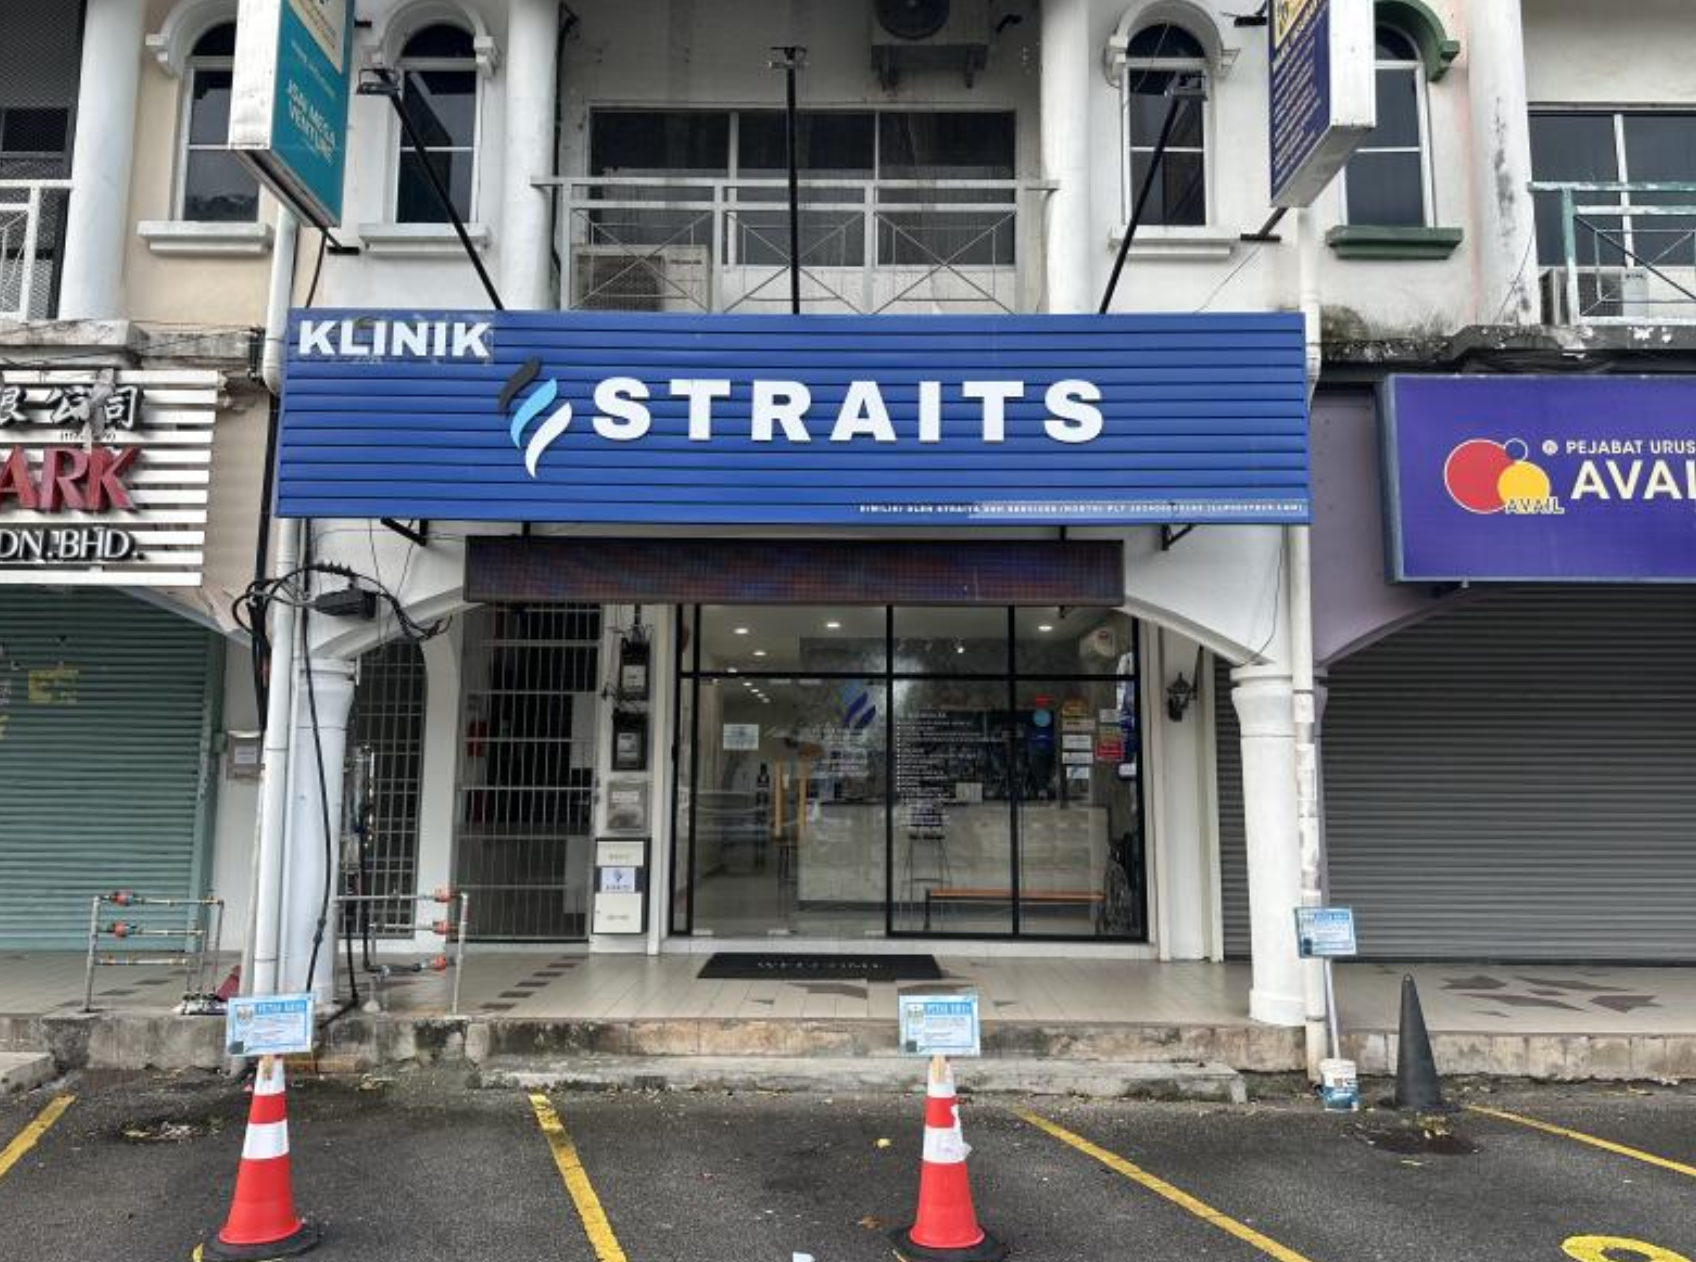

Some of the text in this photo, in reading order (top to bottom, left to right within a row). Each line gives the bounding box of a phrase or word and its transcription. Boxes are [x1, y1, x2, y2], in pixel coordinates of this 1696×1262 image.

[298, 320, 491, 357] KLINIK
[592, 376, 1103, 442] STRAITS
[1566, 440, 1643, 454] PEJABAT
[1505, 496, 1565, 514] AVAIL
